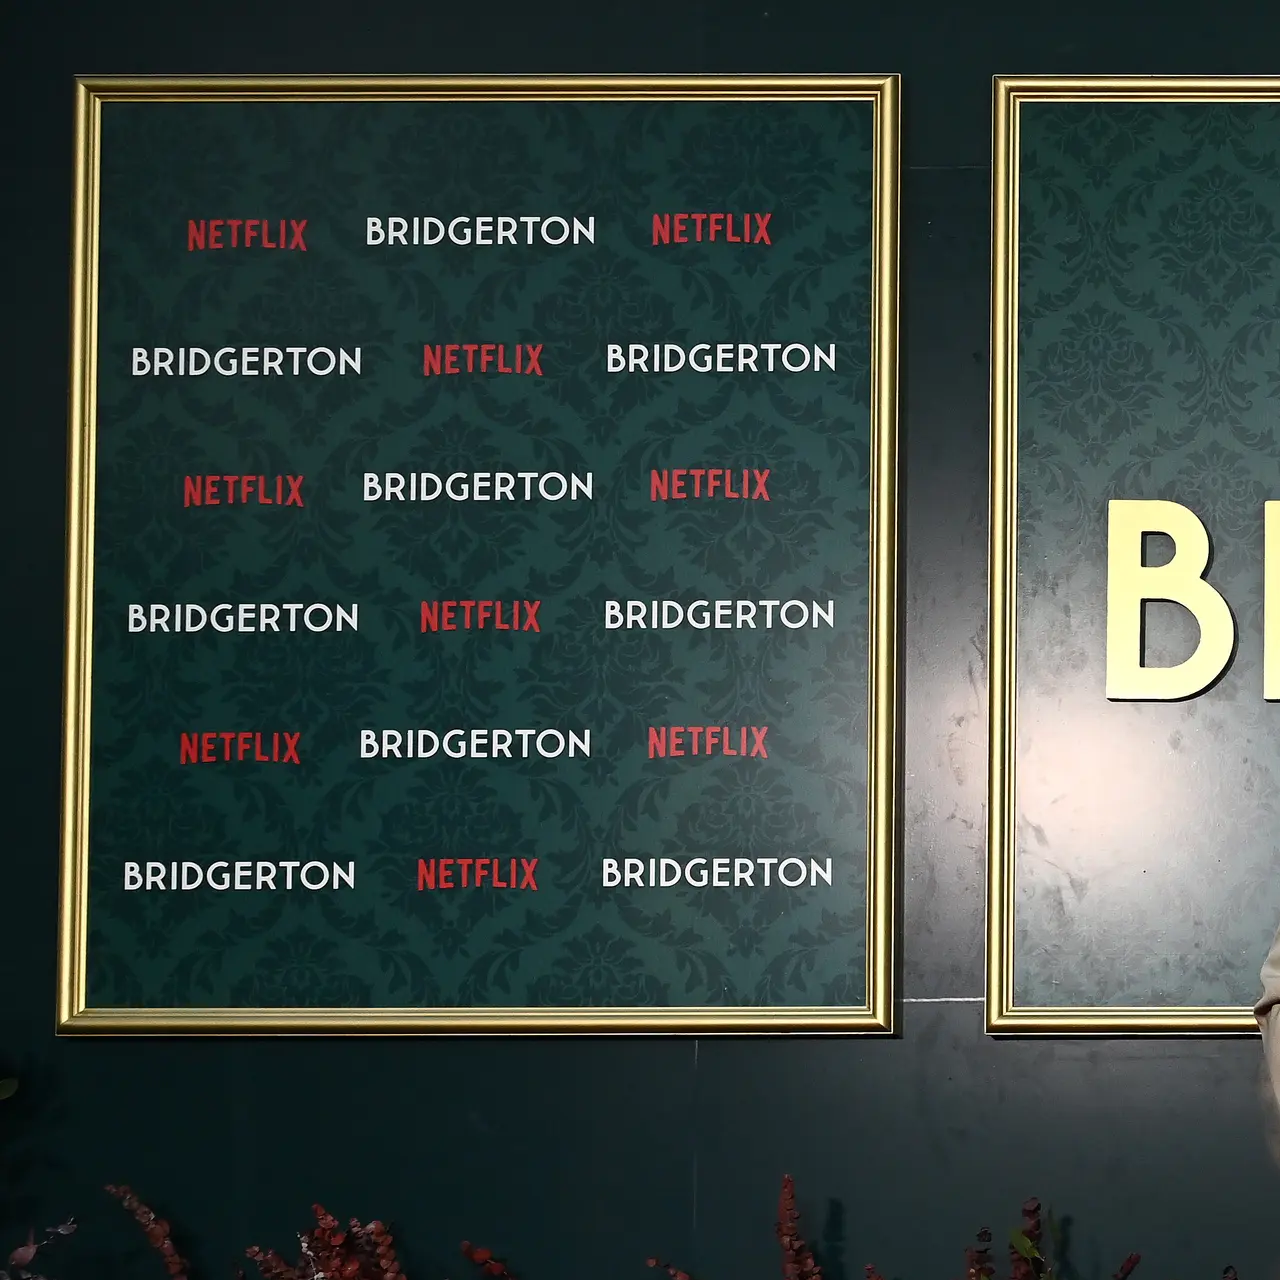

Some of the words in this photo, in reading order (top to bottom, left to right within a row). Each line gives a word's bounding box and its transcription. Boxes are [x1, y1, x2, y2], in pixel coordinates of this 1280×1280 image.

[188, 219, 308, 251] NETFLIX
[366, 216, 595, 246] BRIDGERTON
[652, 213, 772, 246] NETFLIX
[132, 346, 361, 376] BRIDGERTON
[423, 343, 543, 377] NETFLIX
[607, 343, 836, 373] BRIDGERTON
[184, 475, 304, 507] NETFLIX
[363, 471, 593, 501] BRIDGERTON
[651, 469, 770, 501] NETFLIX
[128, 603, 358, 633] BRIDGERTON
[421, 600, 541, 633] NETFLIX
[605, 599, 834, 629] BRIDGERTON
[180, 731, 301, 765] NETFLIX
[360, 728, 591, 759] BRIDGERTON
[648, 726, 768, 759] NETFLIX
[124, 860, 355, 891] BRIDGERTON
[417, 858, 539, 891] NETFLIX
[602, 857, 833, 888] BRIDGERTON
